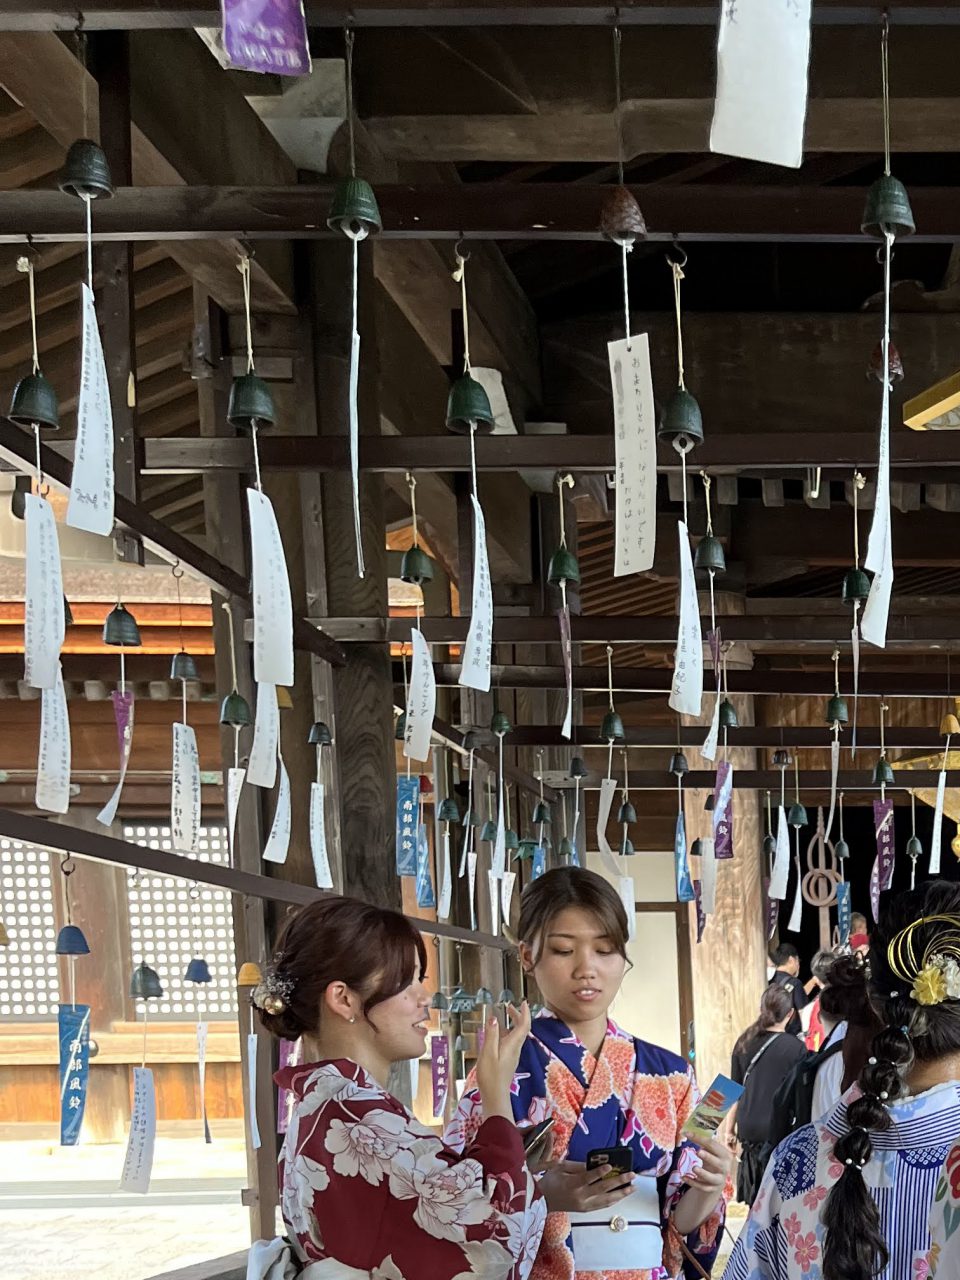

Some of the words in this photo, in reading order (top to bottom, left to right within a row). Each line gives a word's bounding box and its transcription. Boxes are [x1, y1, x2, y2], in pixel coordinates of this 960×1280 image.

[402, 800, 413, 850] 南部風鈴
[68, 1040, 83, 1109] 南部風鈴
[436, 1055, 445, 1097] 南部風鈴
